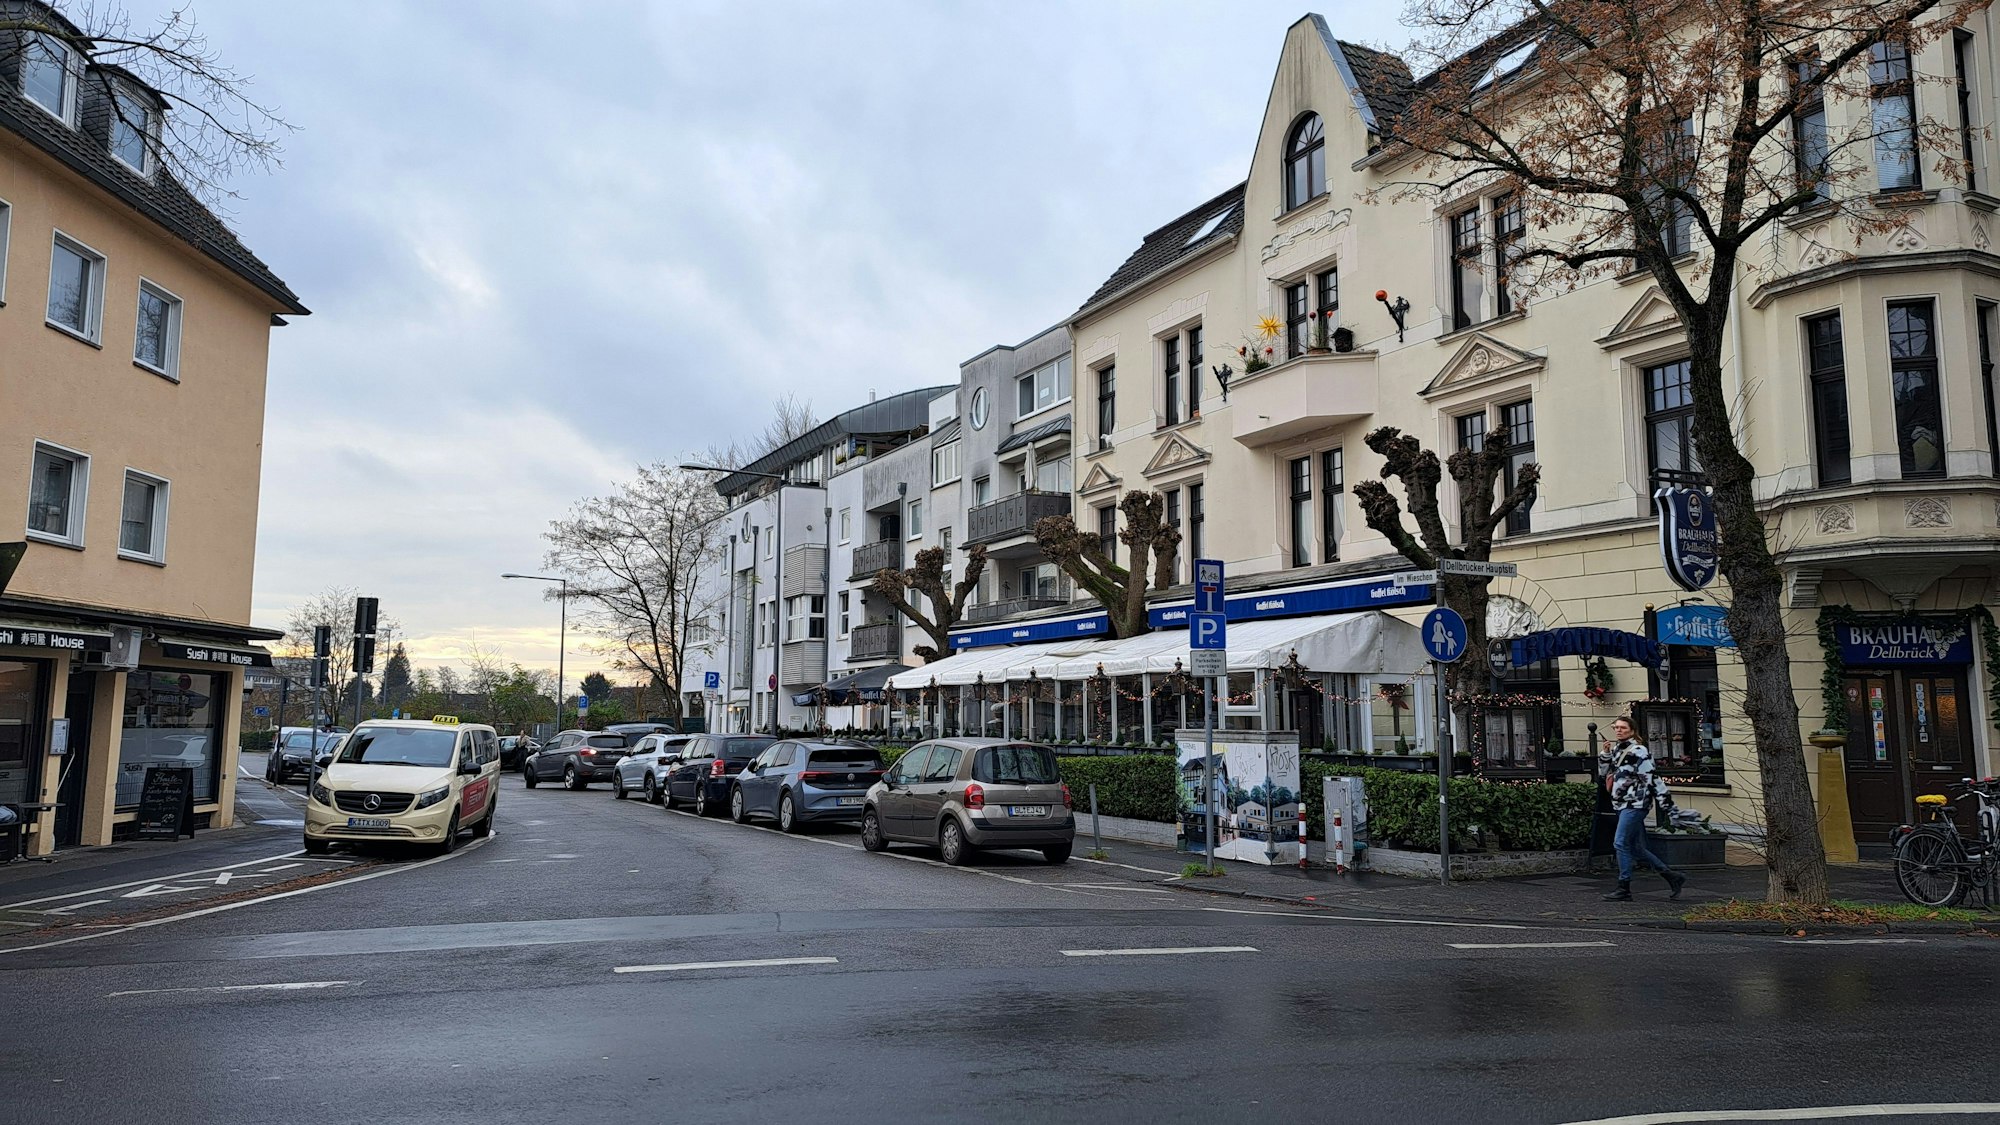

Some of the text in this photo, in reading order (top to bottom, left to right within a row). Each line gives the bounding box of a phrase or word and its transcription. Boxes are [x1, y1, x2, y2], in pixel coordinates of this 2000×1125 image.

[1446, 560, 1515, 575] Dellbrücker Hauptstr.
[1396, 574, 1404, 583] Im
[1198, 618, 1218, 645] P
[1675, 614, 1714, 639] Gaffel
[1849, 626, 1957, 644] BRAUHAUS
[0, 630, 13, 644] shi
[50, 634, 84, 649] House
[187, 648, 208, 661] Sushi
[231, 653, 252, 665] House
[1868, 645, 1934, 659] Dellbrück
[708, 673, 716, 686] P
